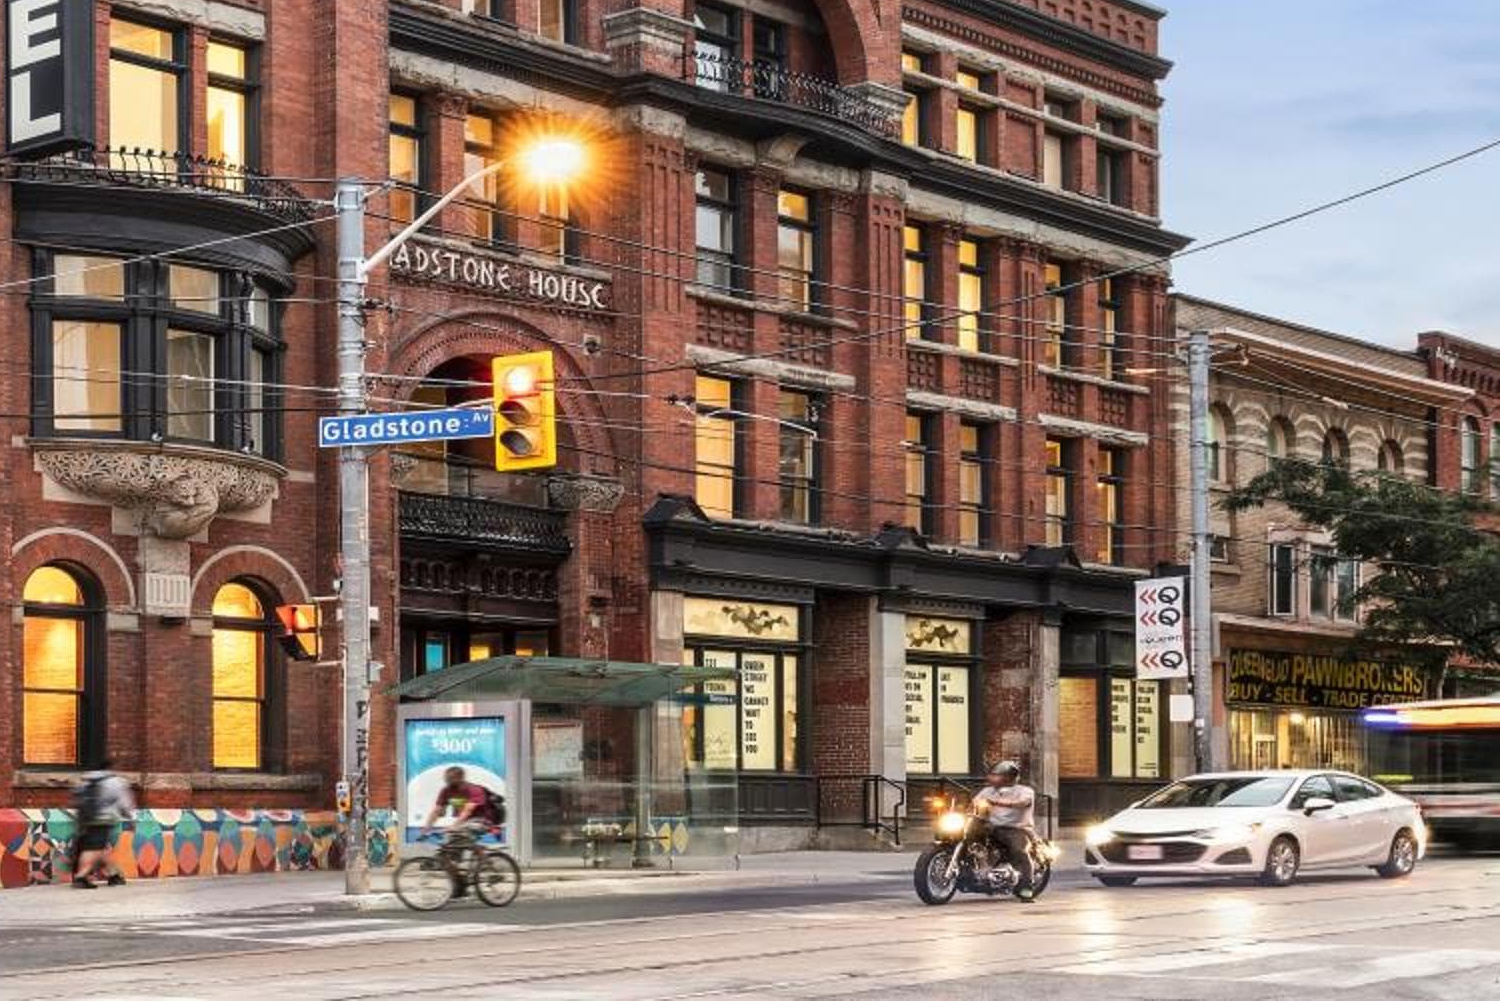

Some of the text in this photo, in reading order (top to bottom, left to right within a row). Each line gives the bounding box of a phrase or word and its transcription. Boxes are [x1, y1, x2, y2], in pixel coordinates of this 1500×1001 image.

[389, 242, 511, 290] LADSTONE
[323, 412, 489, 440] Gladstone Av
[1275, 686, 1309, 704] SELL
[1322, 689, 1369, 708] TRADE
